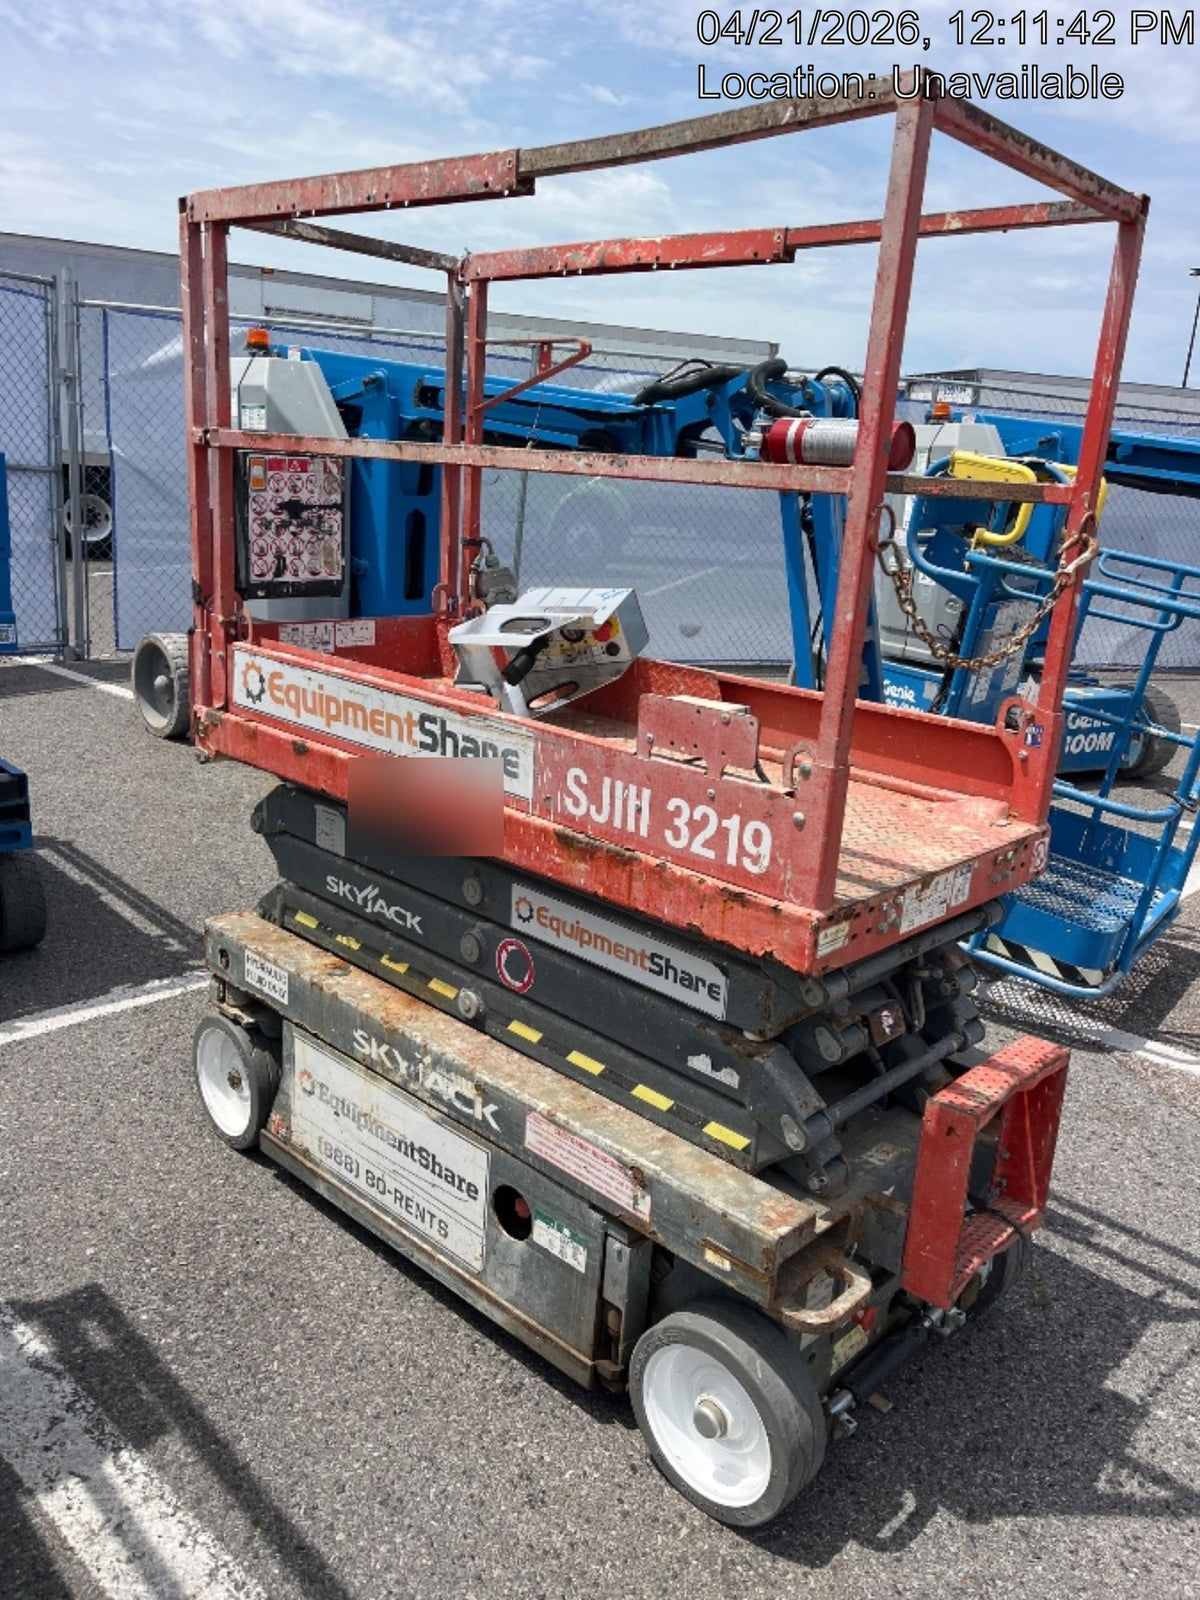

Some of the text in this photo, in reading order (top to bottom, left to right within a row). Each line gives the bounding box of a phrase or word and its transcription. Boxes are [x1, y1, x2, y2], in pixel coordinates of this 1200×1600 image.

[664, 797, 773, 875] 3219
[326, 875, 424, 935] SKYJACK
[536, 905, 722, 1002] EquipmentShare
[317, 1136, 449, 1239] (888) 80-RENTS
